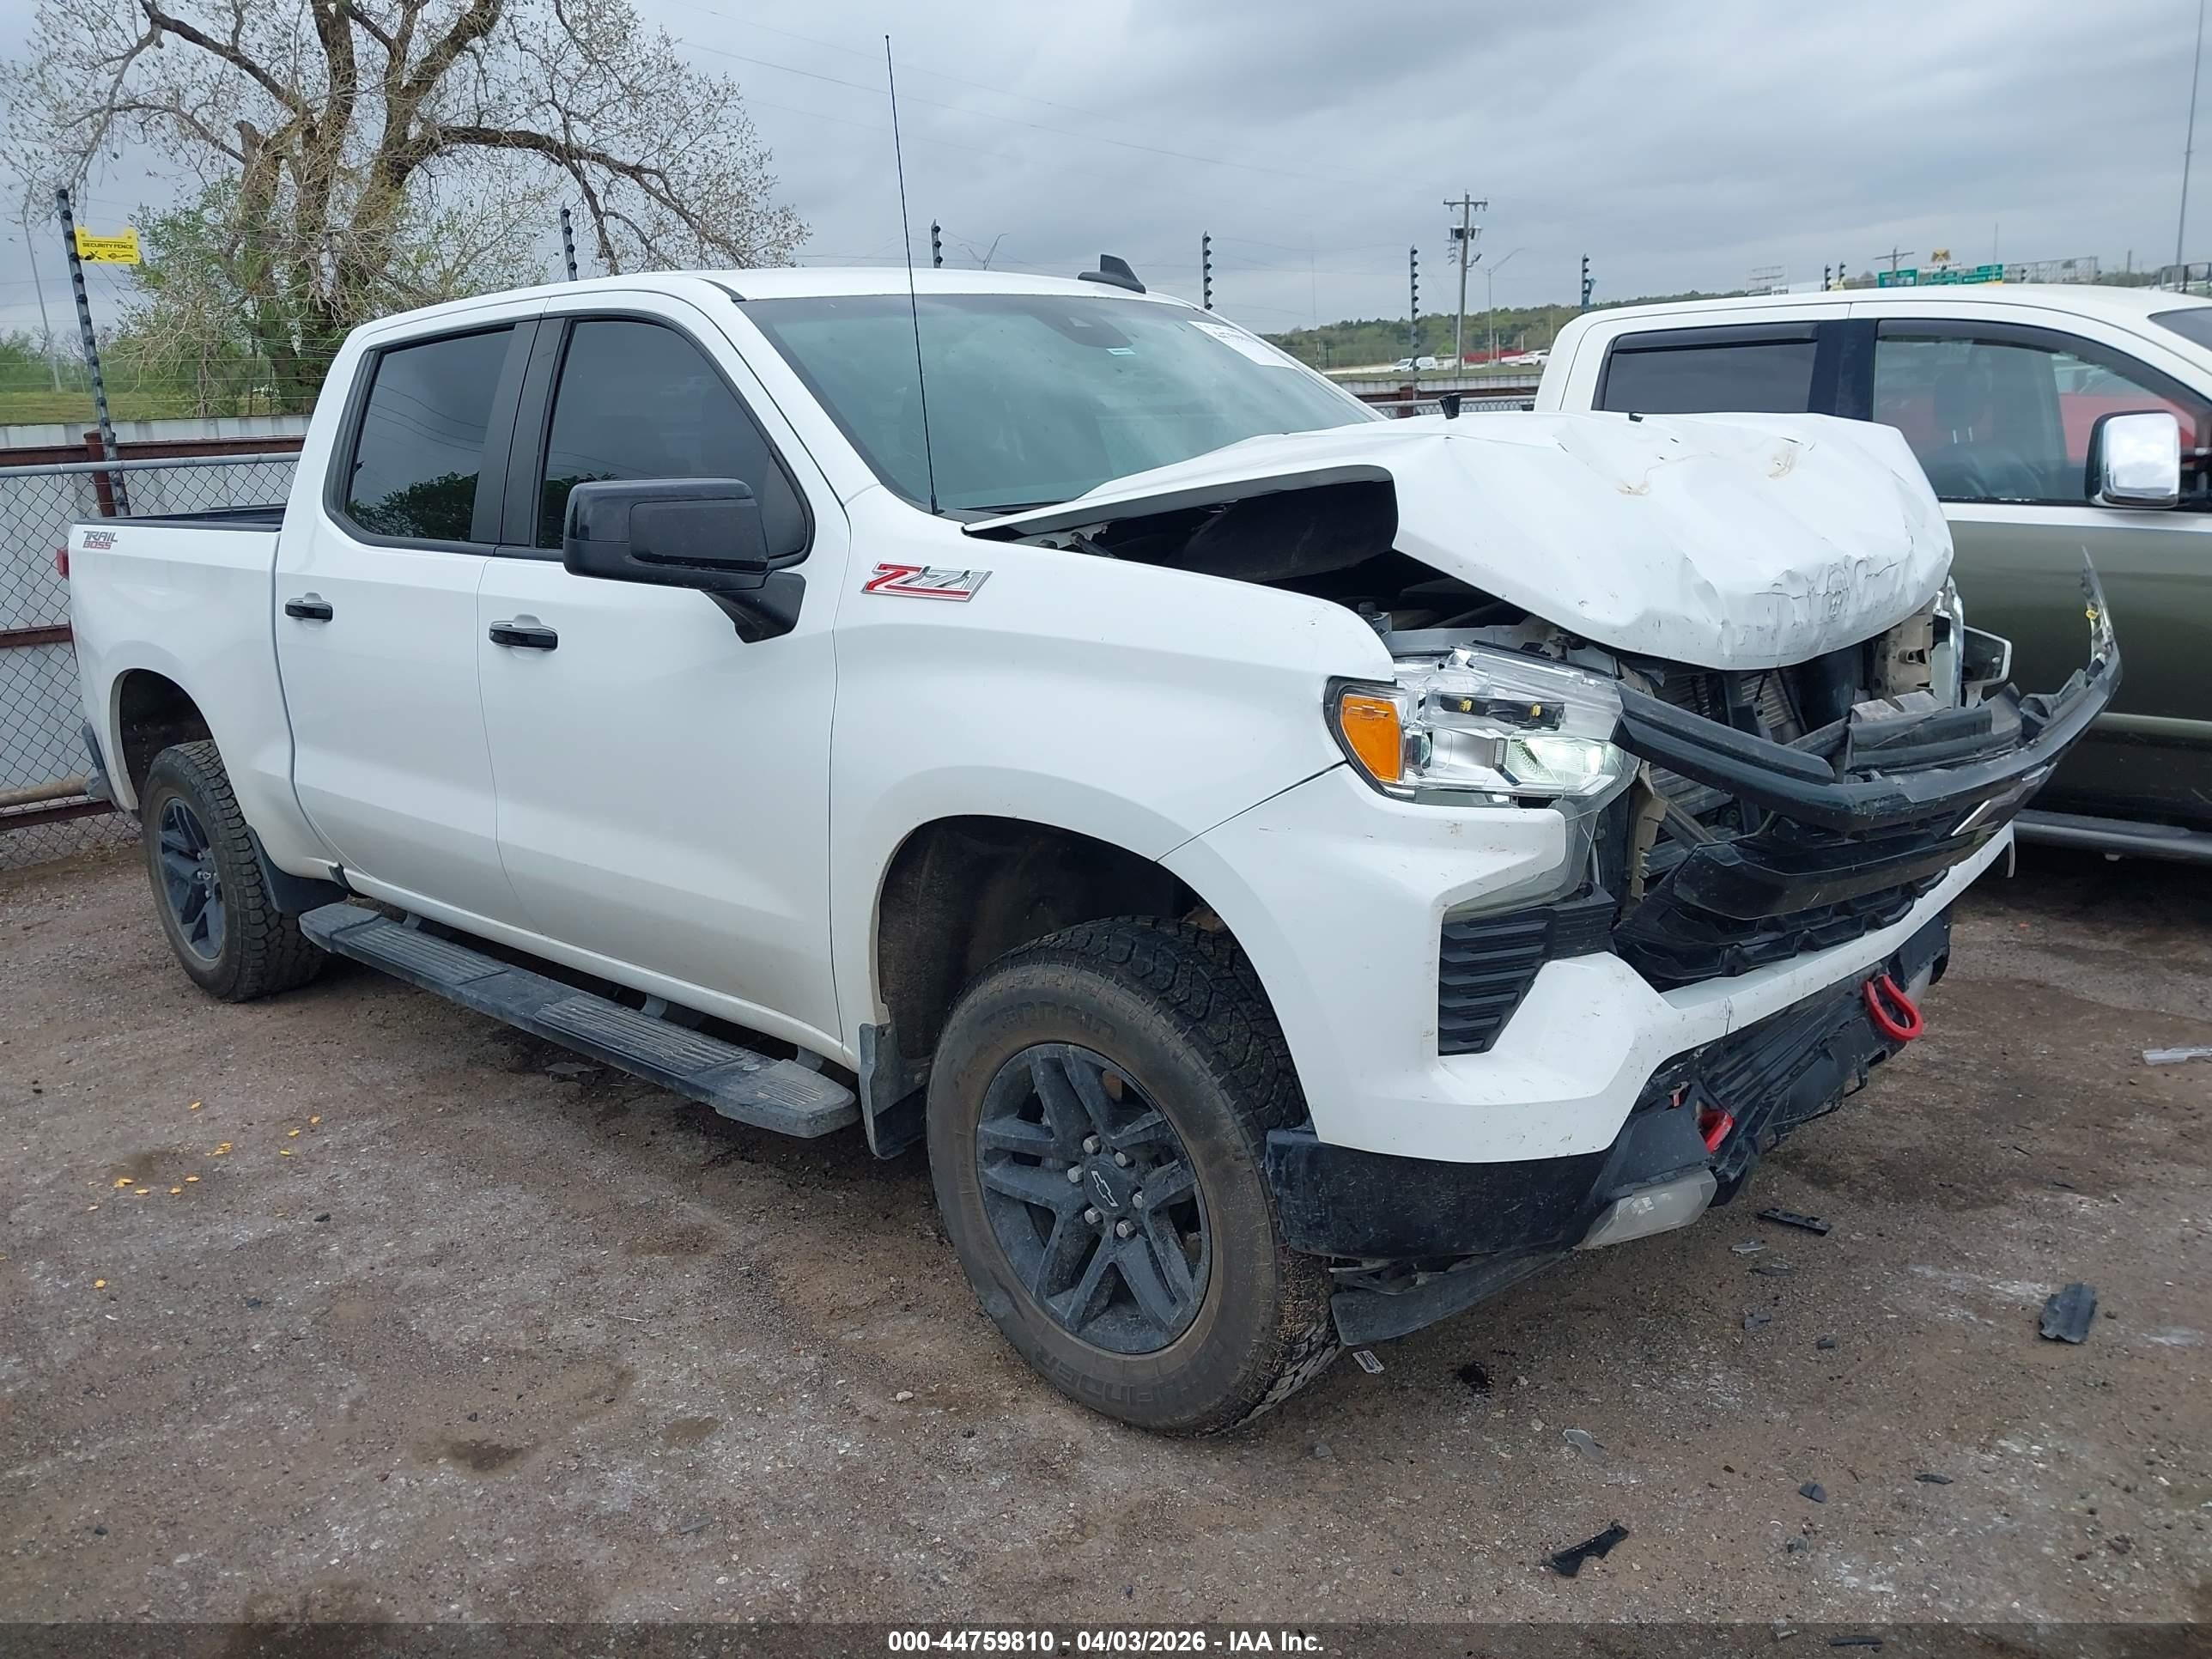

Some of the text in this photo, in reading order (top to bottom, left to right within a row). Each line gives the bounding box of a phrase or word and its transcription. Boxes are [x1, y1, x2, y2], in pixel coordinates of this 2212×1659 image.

[83, 531, 118, 543] TRAIL
[83, 540, 112, 550] BOSS
[860, 562, 993, 603] Z71
